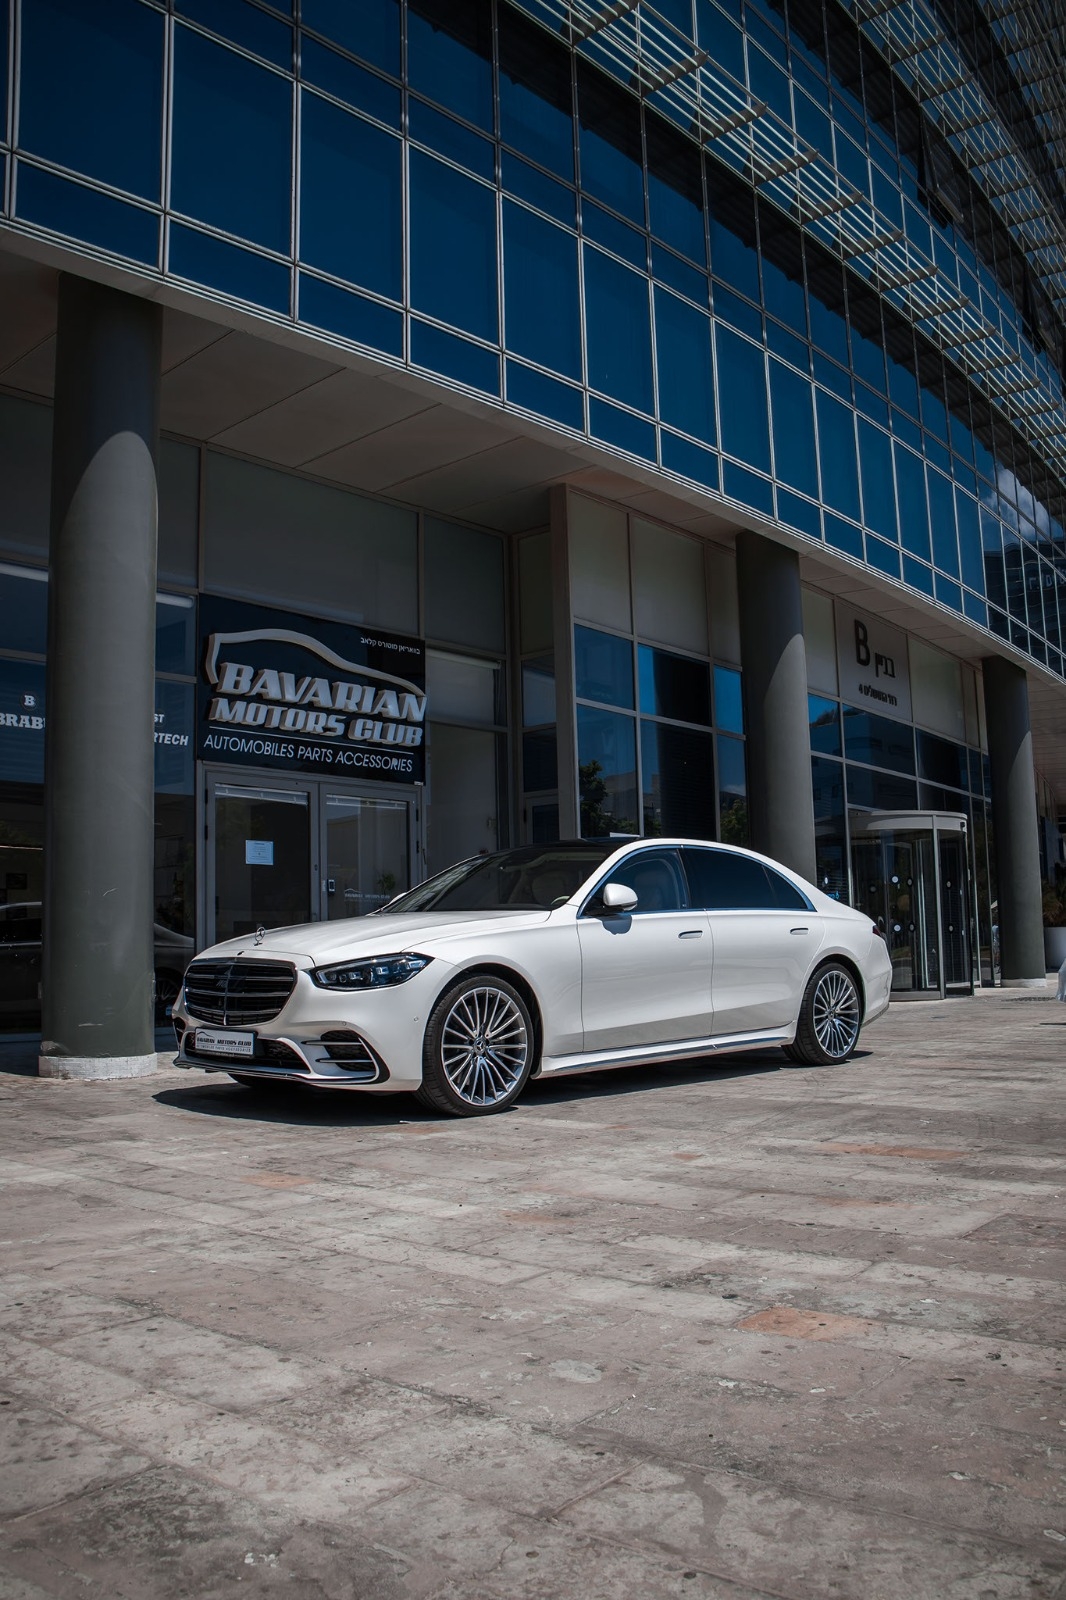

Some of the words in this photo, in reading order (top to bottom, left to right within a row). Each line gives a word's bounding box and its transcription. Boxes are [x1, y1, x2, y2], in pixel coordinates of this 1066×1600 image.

[854, 618, 871, 667] B
[24, 694, 35, 706] B
[216, 661, 428, 722] BAVARIAN
[0, 712, 45, 730] RAB
[208, 697, 347, 736] MOTORS
[347, 718, 423, 747] CLUB
[203, 734, 294, 758] AUTOMOBILES
[297, 746, 333, 763] PARTS
[334, 751, 413, 773] ACCESSORIES
